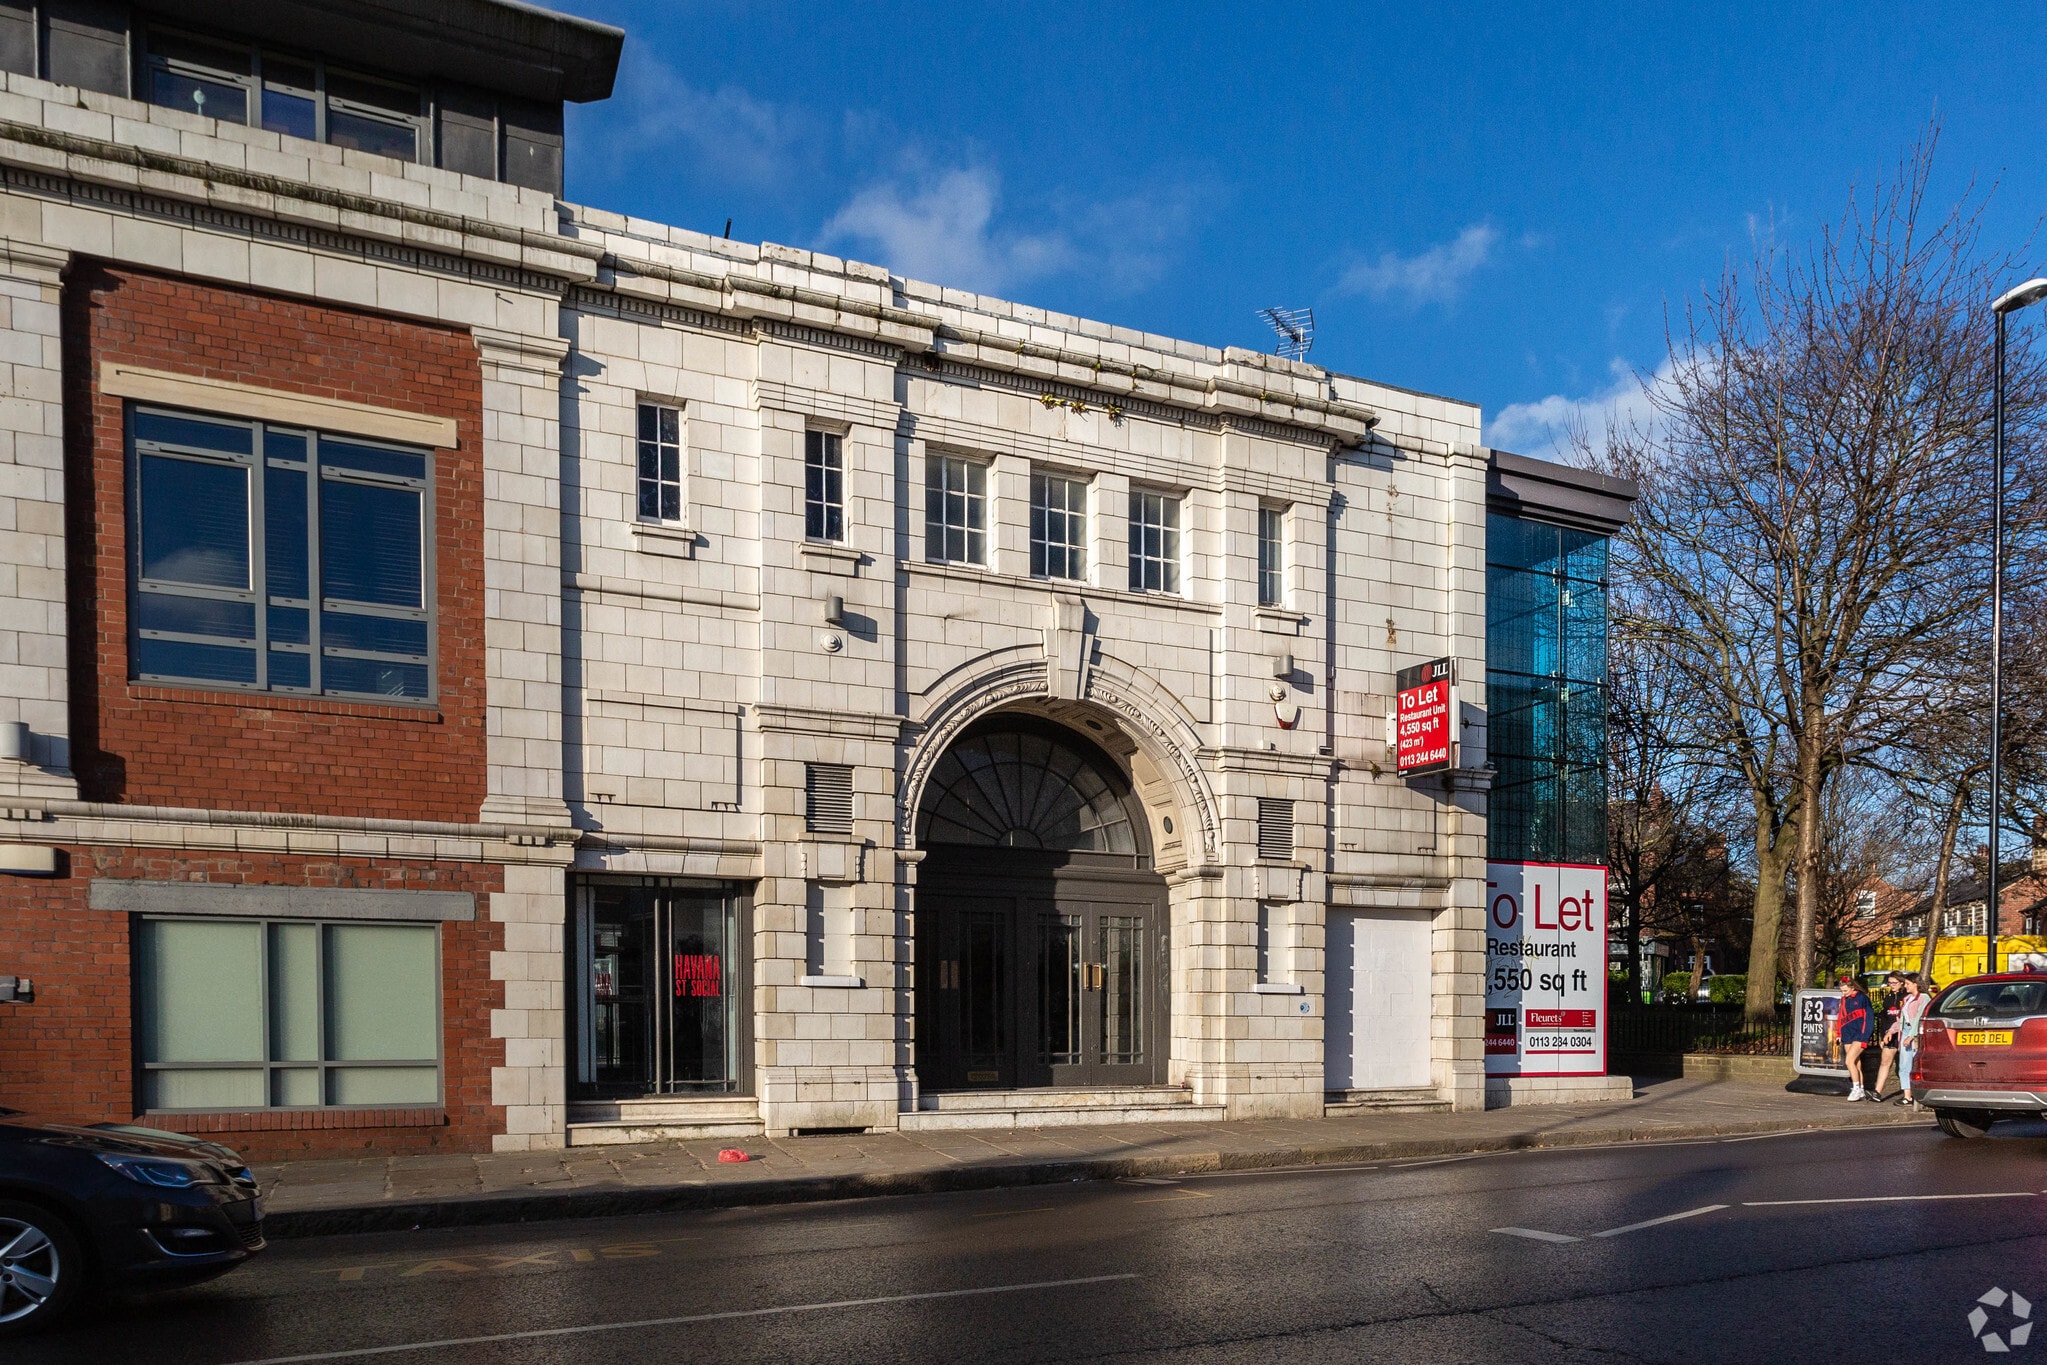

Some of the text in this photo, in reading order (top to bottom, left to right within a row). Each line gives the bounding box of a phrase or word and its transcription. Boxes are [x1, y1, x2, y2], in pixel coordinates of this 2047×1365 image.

[1432, 663, 1448, 678] JLL
[1400, 685, 1438, 710] To Let
[1400, 703, 1446, 723] Restaurant Unit
[1400, 717, 1439, 737] 4,550 sq ft
[1400, 739, 1412, 751] (423
[1400, 747, 1446, 767] 0113 244 6440
[1535, 884, 1594, 932] Let
[1487, 937, 1577, 958] Restaurant
[675, 954, 720, 980] HAVANA
[676, 980, 720, 997] ST SOCIAL
[1540, 973, 1565, 997] sq
[1572, 969, 1587, 991] ft
[1496, 1013, 1515, 1026] JLL
[1530, 1012, 1562, 1023] Fleurets
[1803, 1000, 1824, 1021] £3
[1802, 1023, 1823, 1034] PINTS
[1498, 1038, 1515, 1046] 6440
[1529, 1036, 1592, 1048] 0113 234 0304
[1961, 1033, 2008, 1044] ST03 DEL
